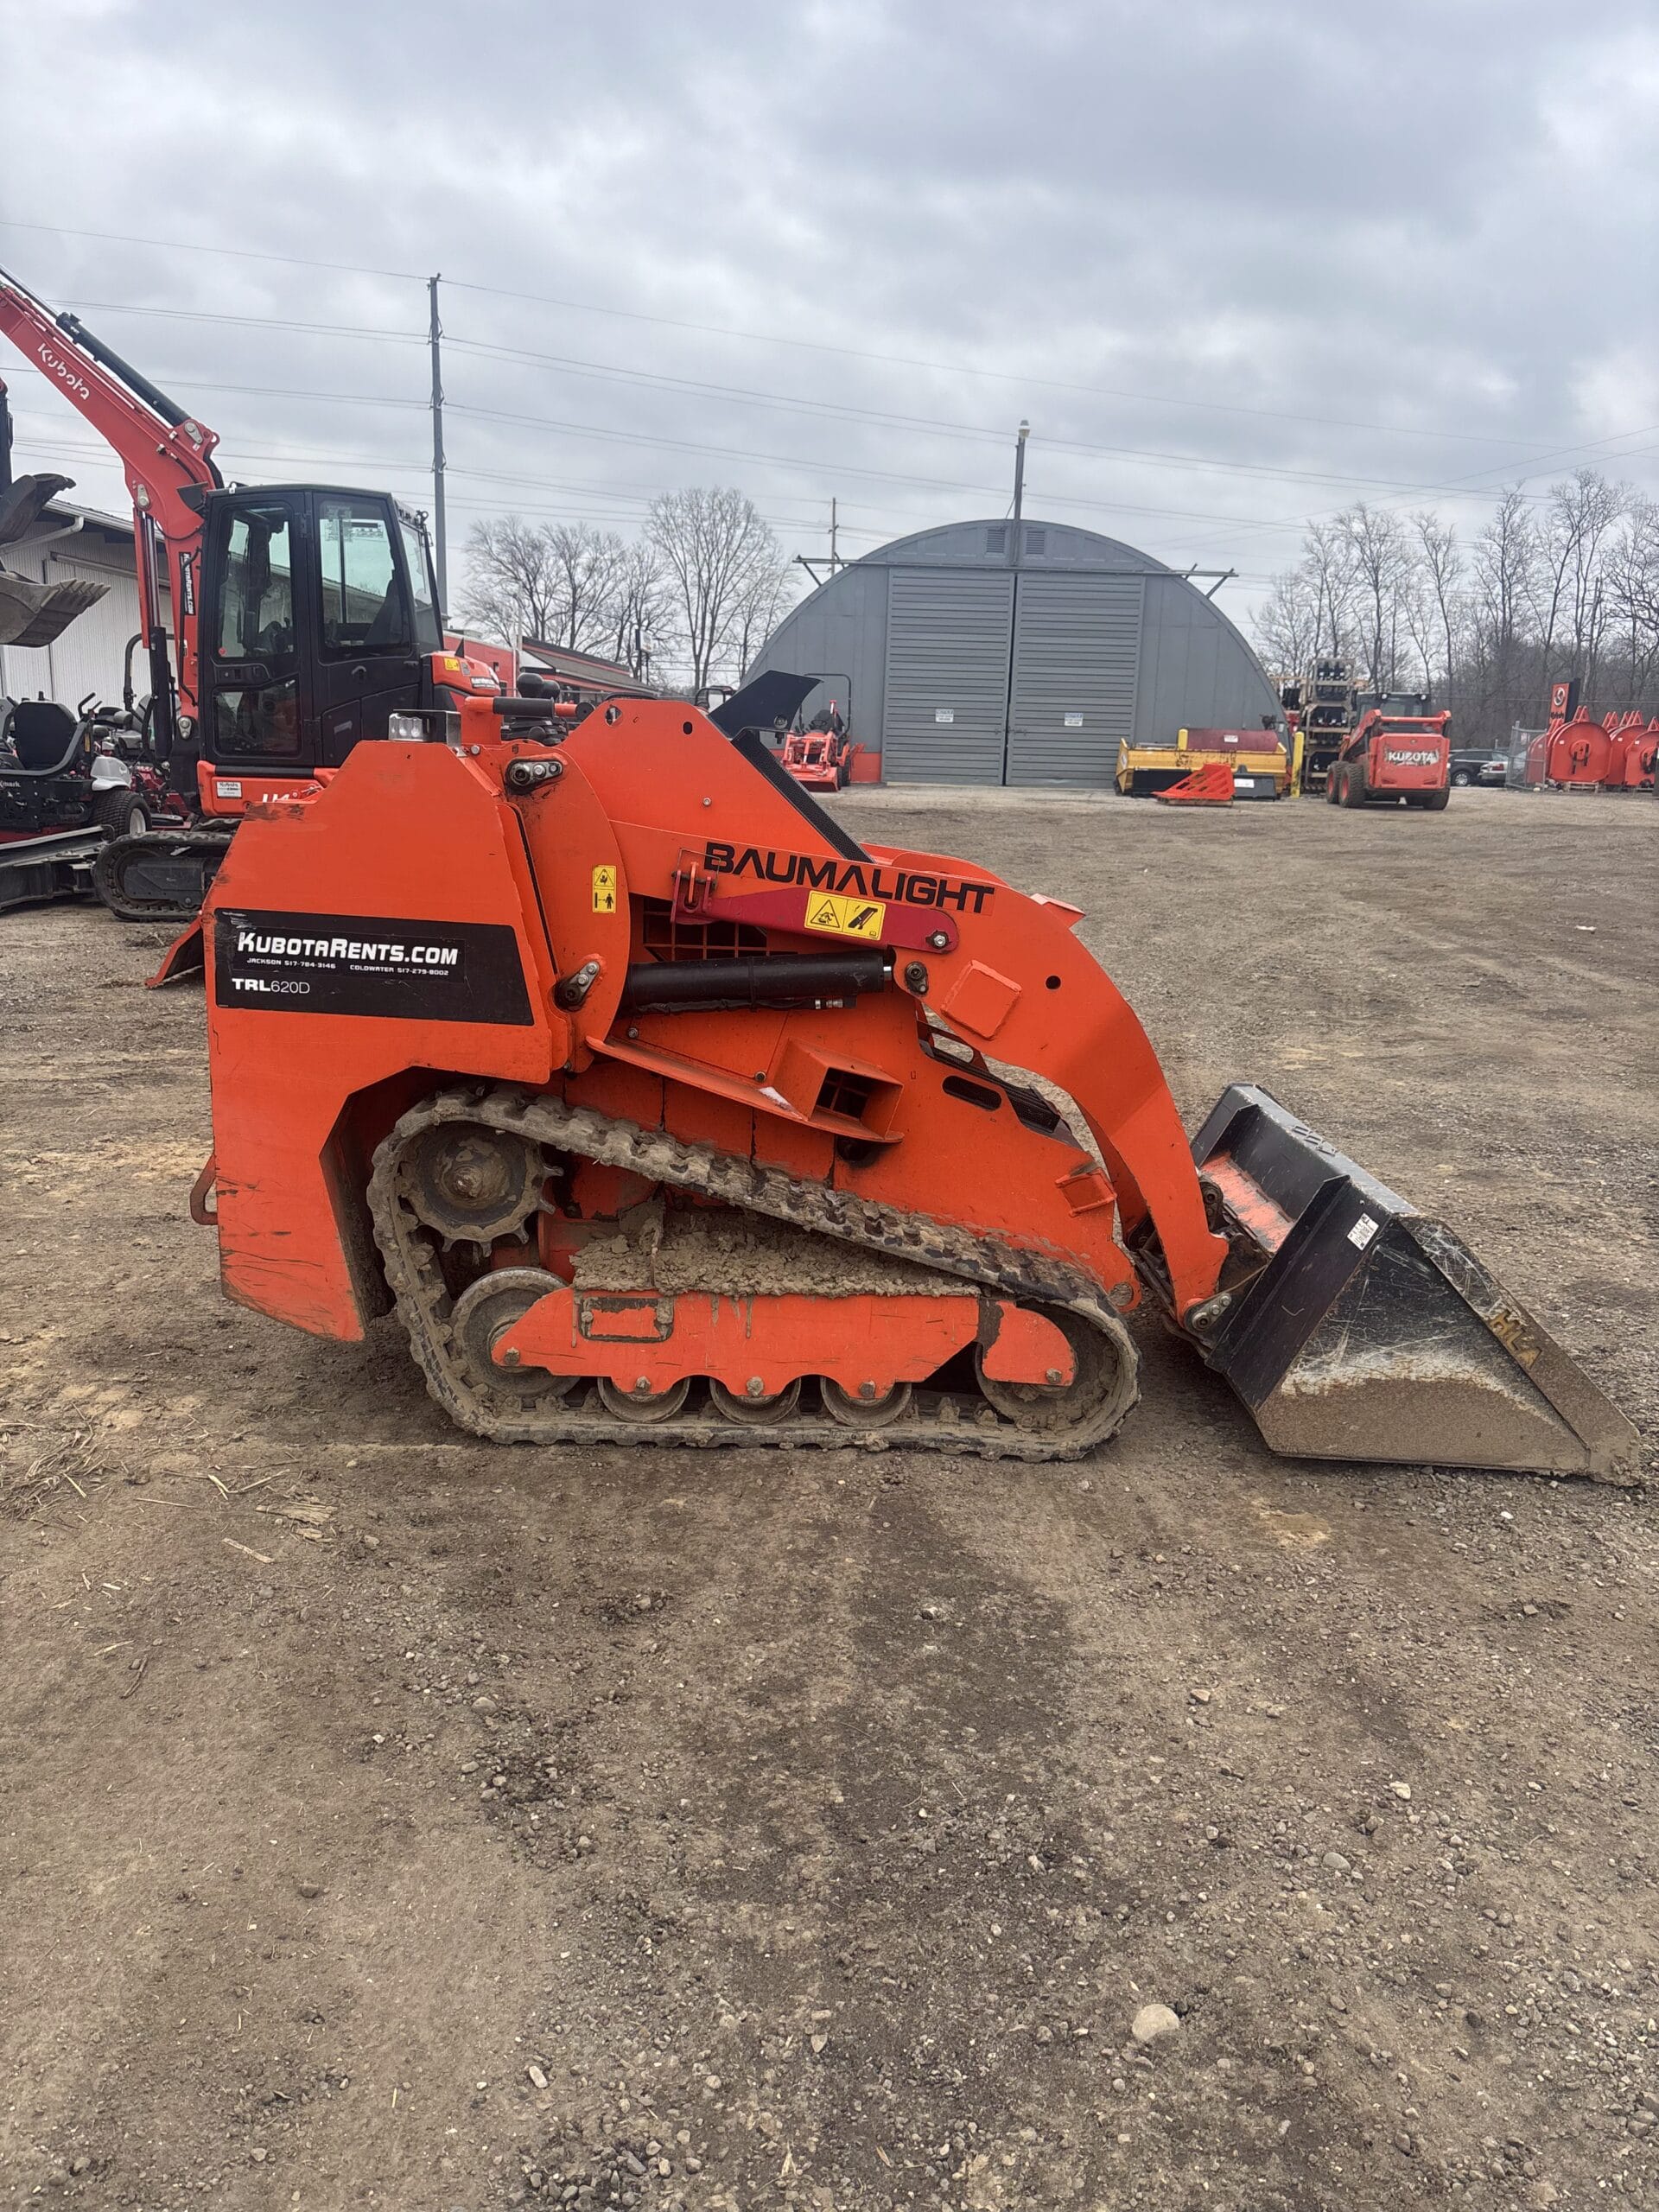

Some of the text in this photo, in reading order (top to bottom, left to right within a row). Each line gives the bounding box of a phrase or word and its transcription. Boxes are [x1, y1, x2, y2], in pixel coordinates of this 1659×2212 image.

[37, 342, 90, 400] Kubota
[1388, 751, 1437, 762] KUBOTA
[704, 842, 995, 913] BAUMALIGHT
[247, 957, 282, 966] JACKSON
[349, 964, 394, 973] COLDWATER
[232, 978, 310, 994] TRL620D
